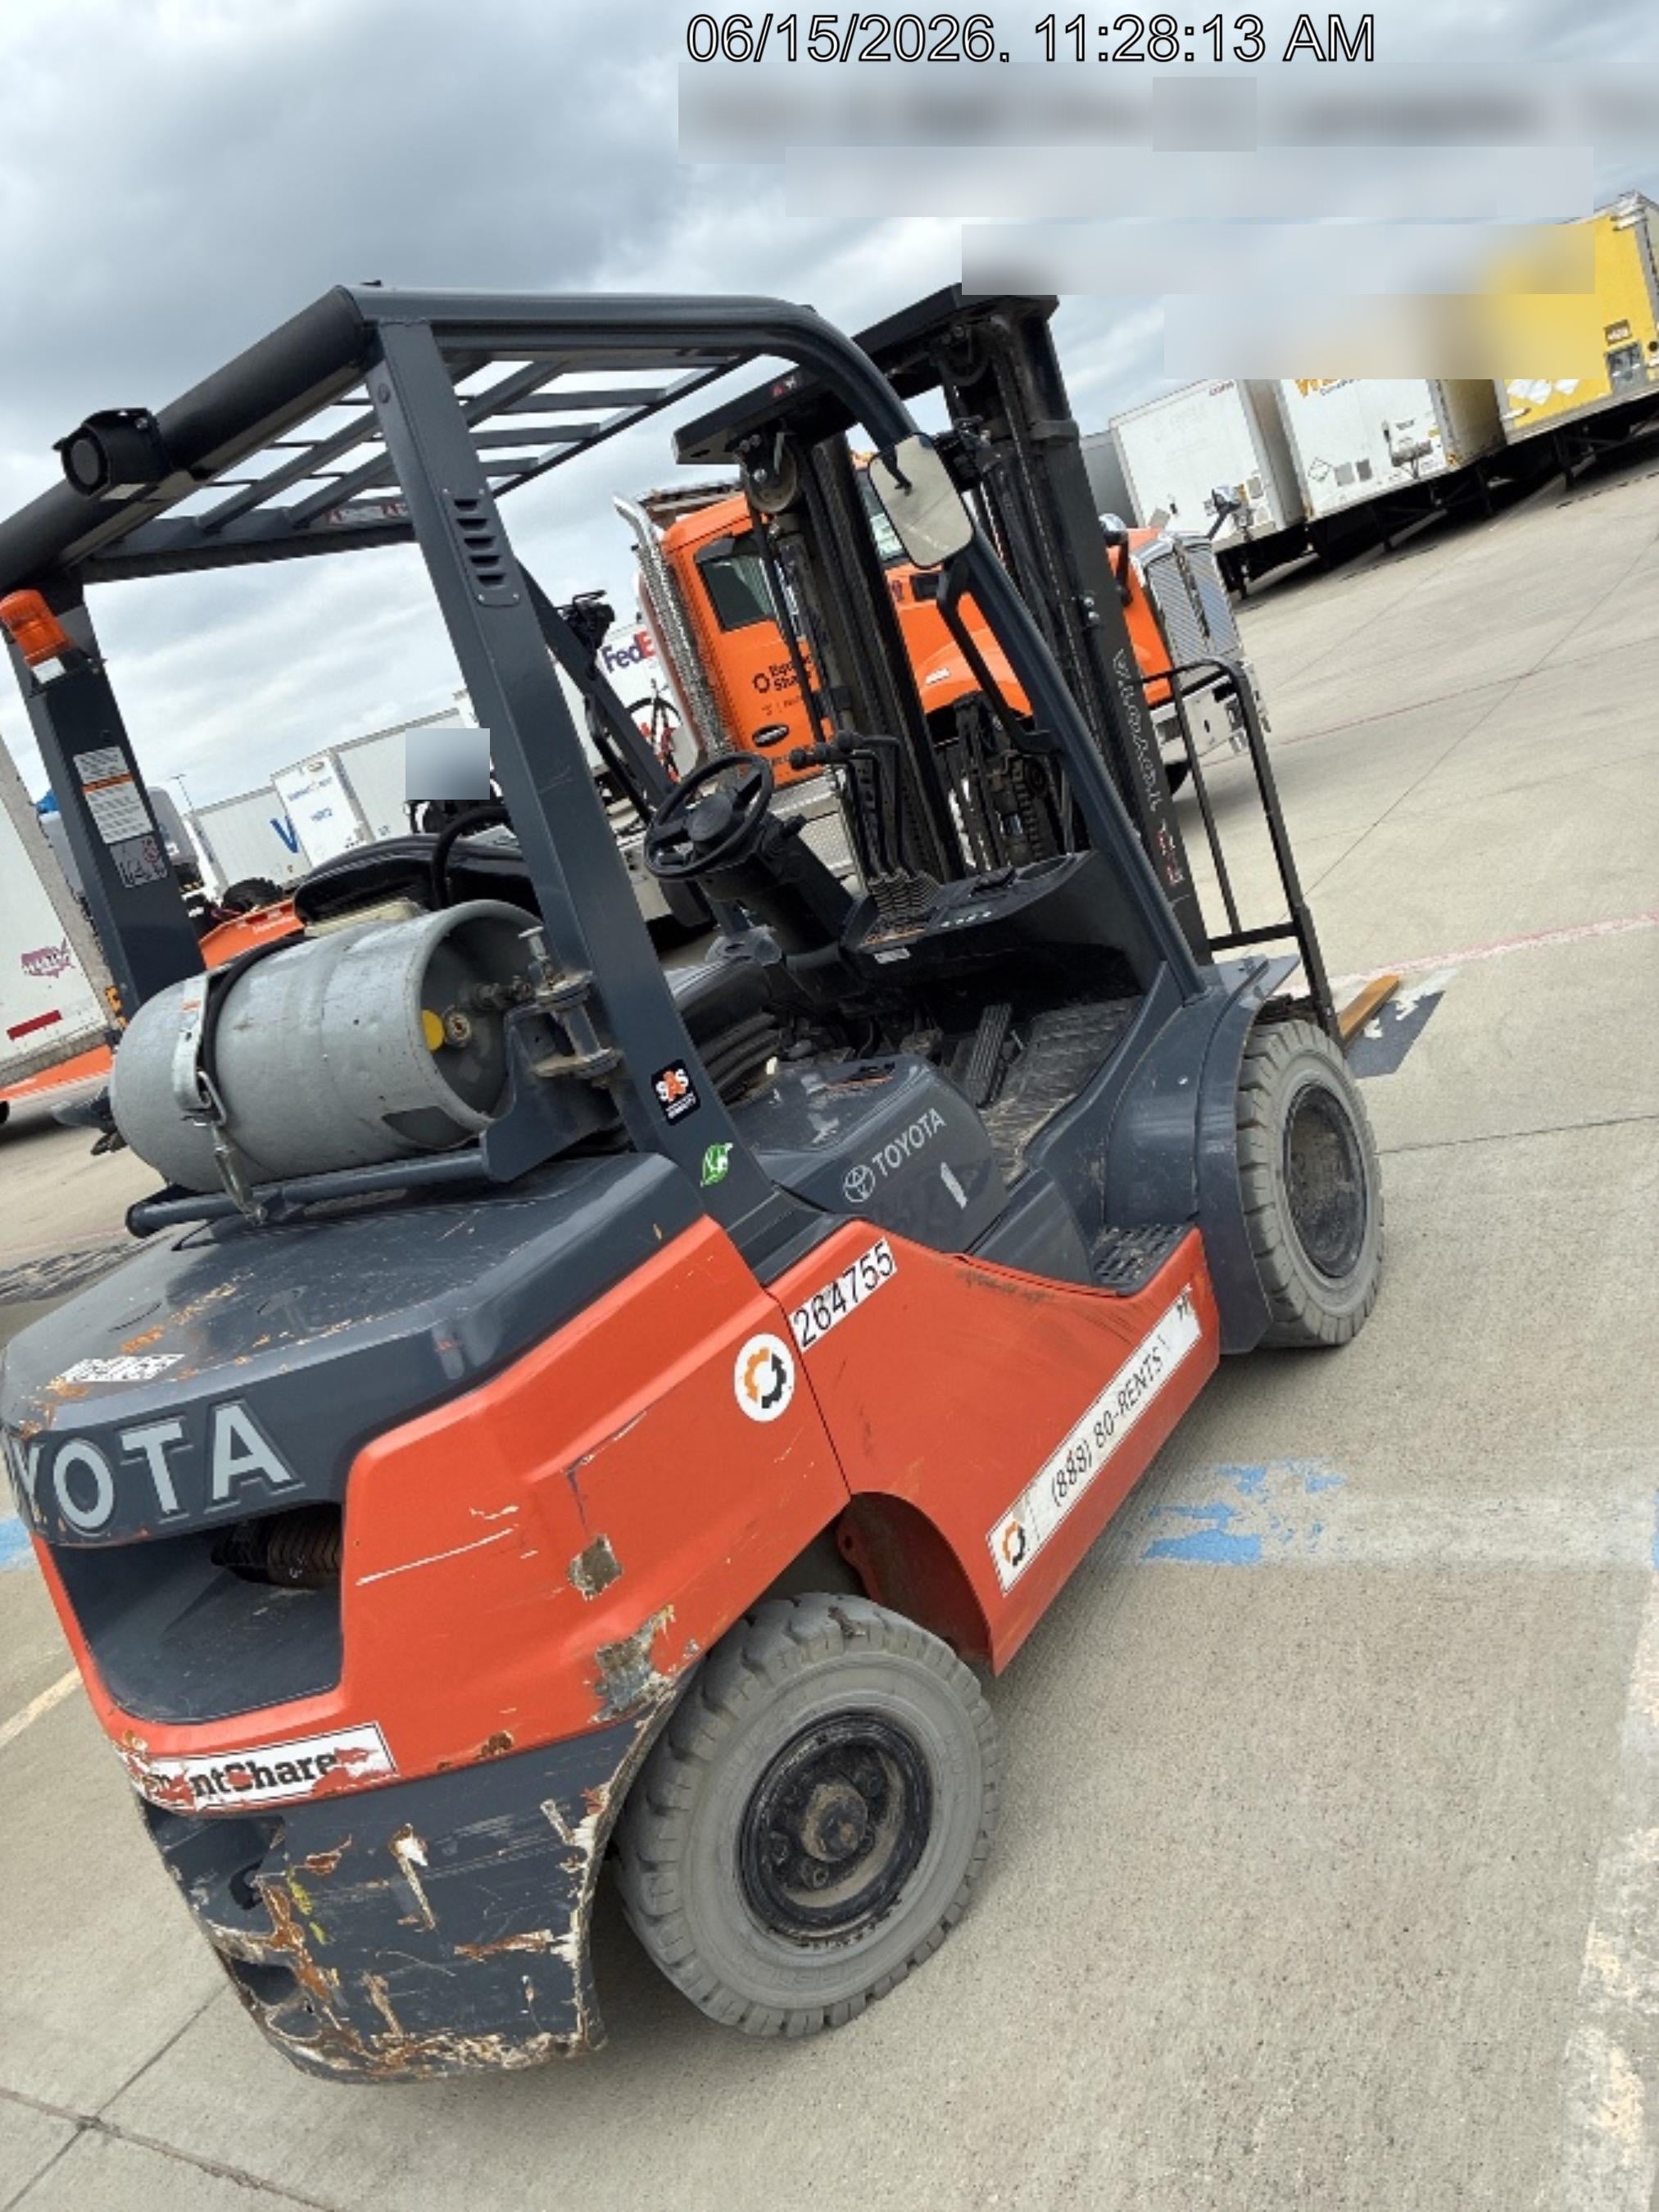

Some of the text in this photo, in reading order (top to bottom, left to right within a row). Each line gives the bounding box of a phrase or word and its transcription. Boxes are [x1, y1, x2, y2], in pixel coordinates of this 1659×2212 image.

[602, 630, 655, 673] FedE
[871, 1108, 947, 1178] TOYOTA
[793, 1240, 893, 1348] 264755
[10, 1402, 292, 1530] YOTA
[1051, 1346, 1164, 1507] (888) 80-RENTS
